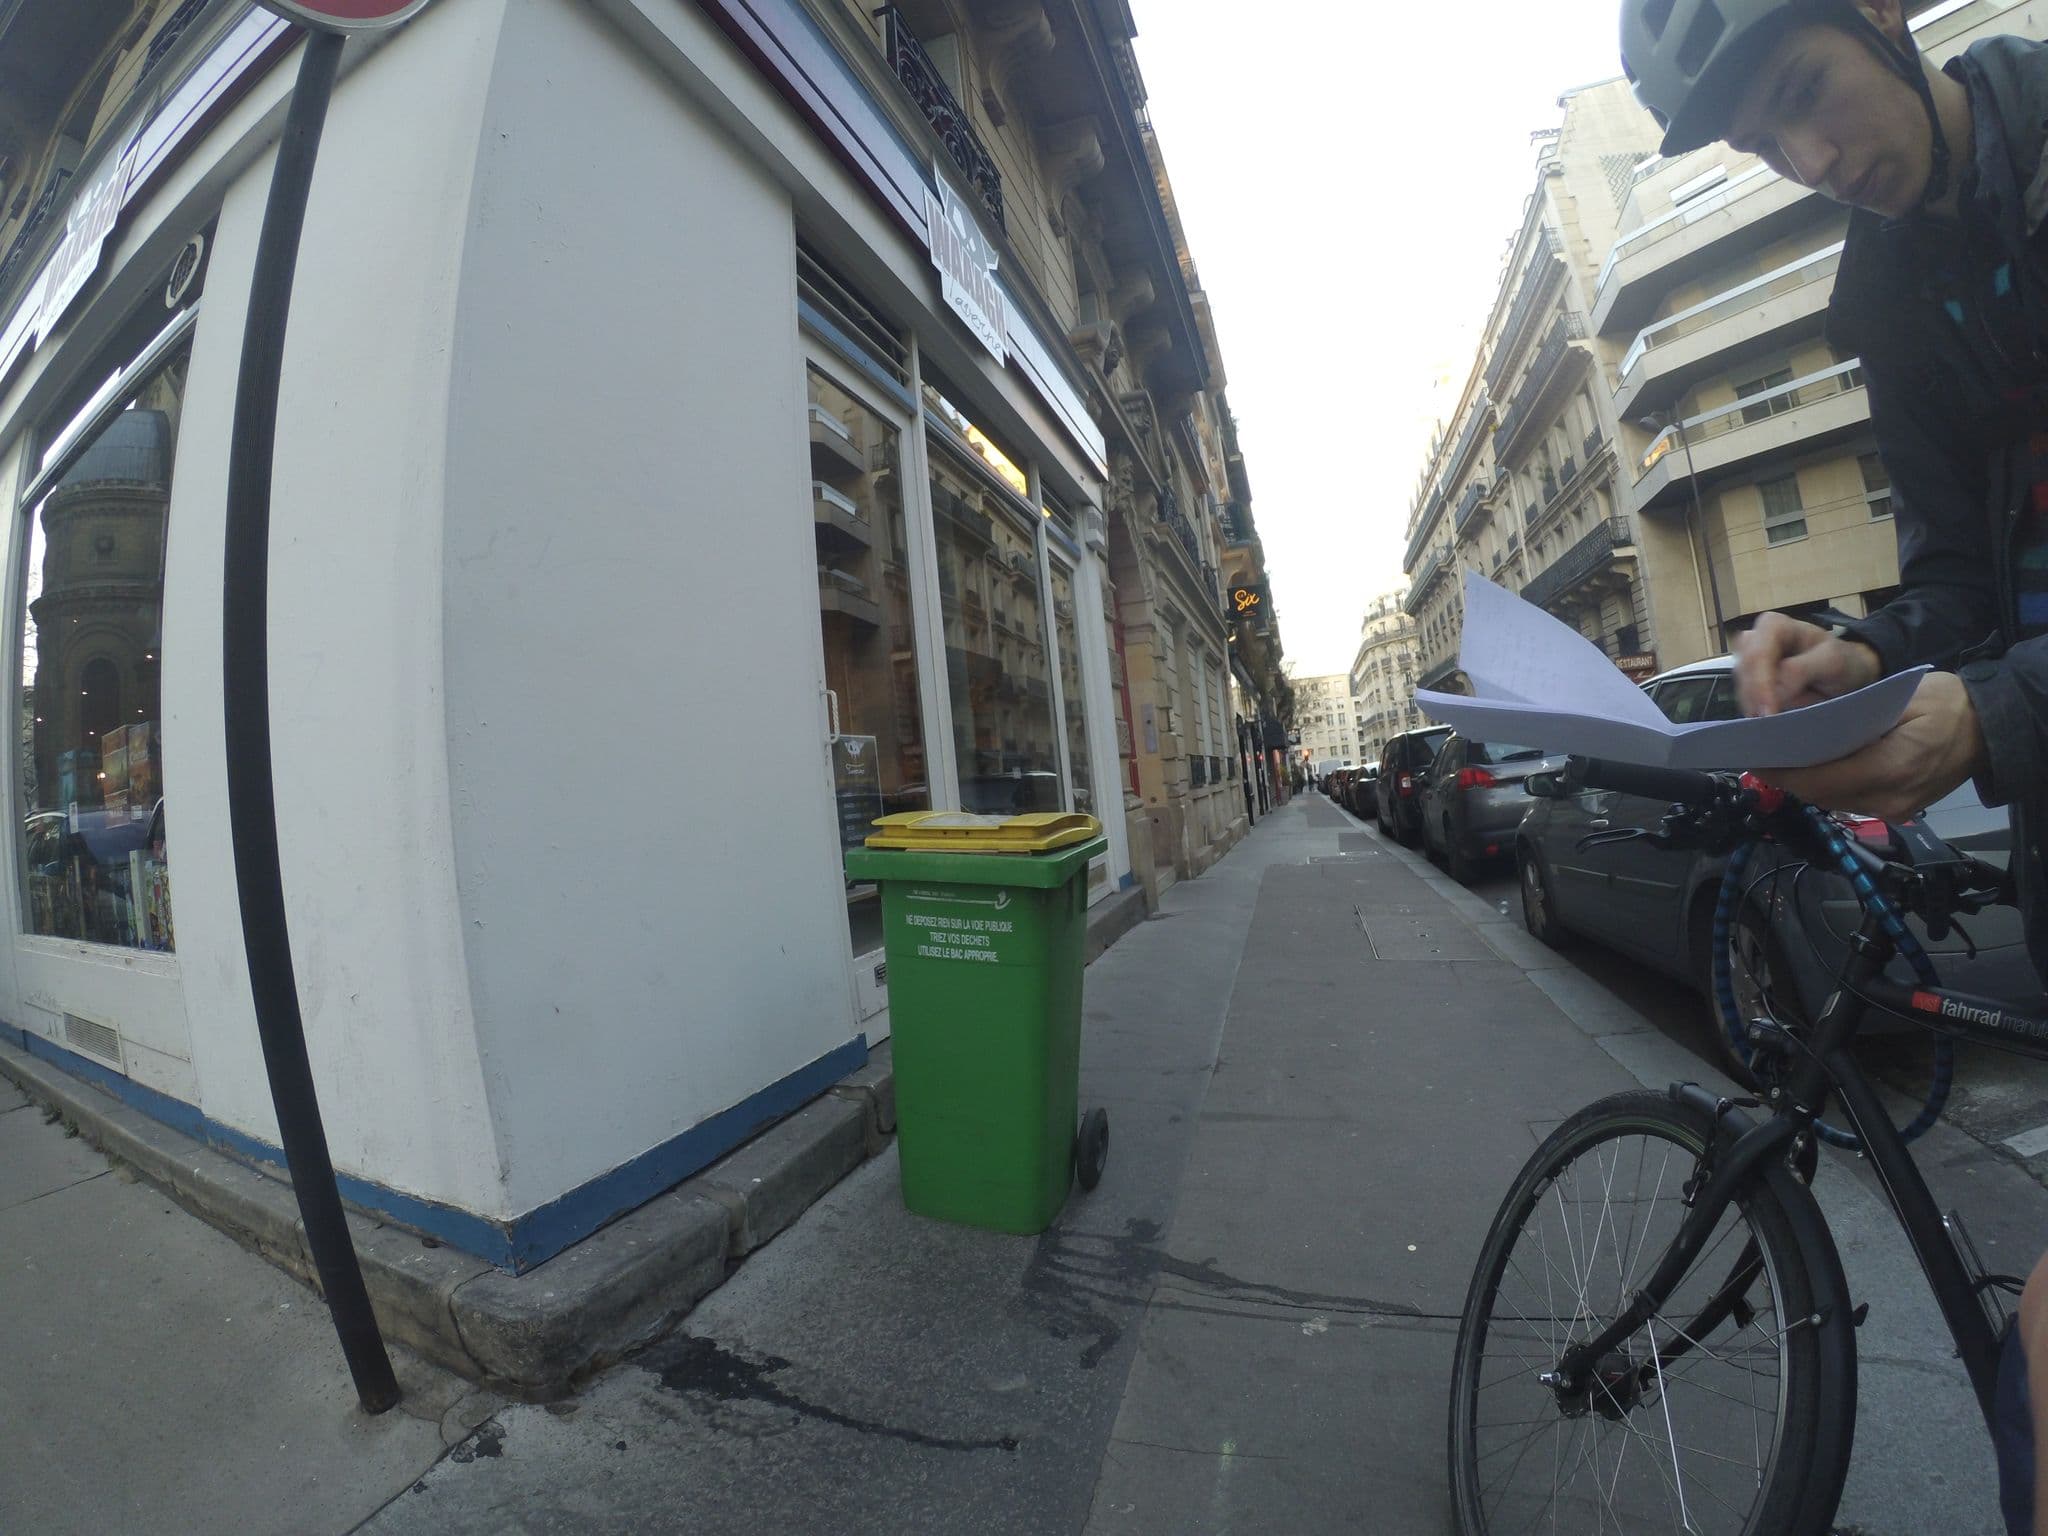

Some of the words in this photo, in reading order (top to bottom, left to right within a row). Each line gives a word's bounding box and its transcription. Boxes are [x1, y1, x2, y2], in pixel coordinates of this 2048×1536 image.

[1235, 589, 1259, 611] Six
[1615, 655, 1653, 668] RESTAURANT
[913, 915, 937, 927] DEPOSEZ
[950, 918, 962, 929] SUR
[929, 931, 947, 943] TRIEZ
[947, 933, 960, 944] VOS
[961, 934, 990, 947] DECHETS
[917, 944, 942, 957] UTILISEZ
[950, 948, 963, 959] BAC
